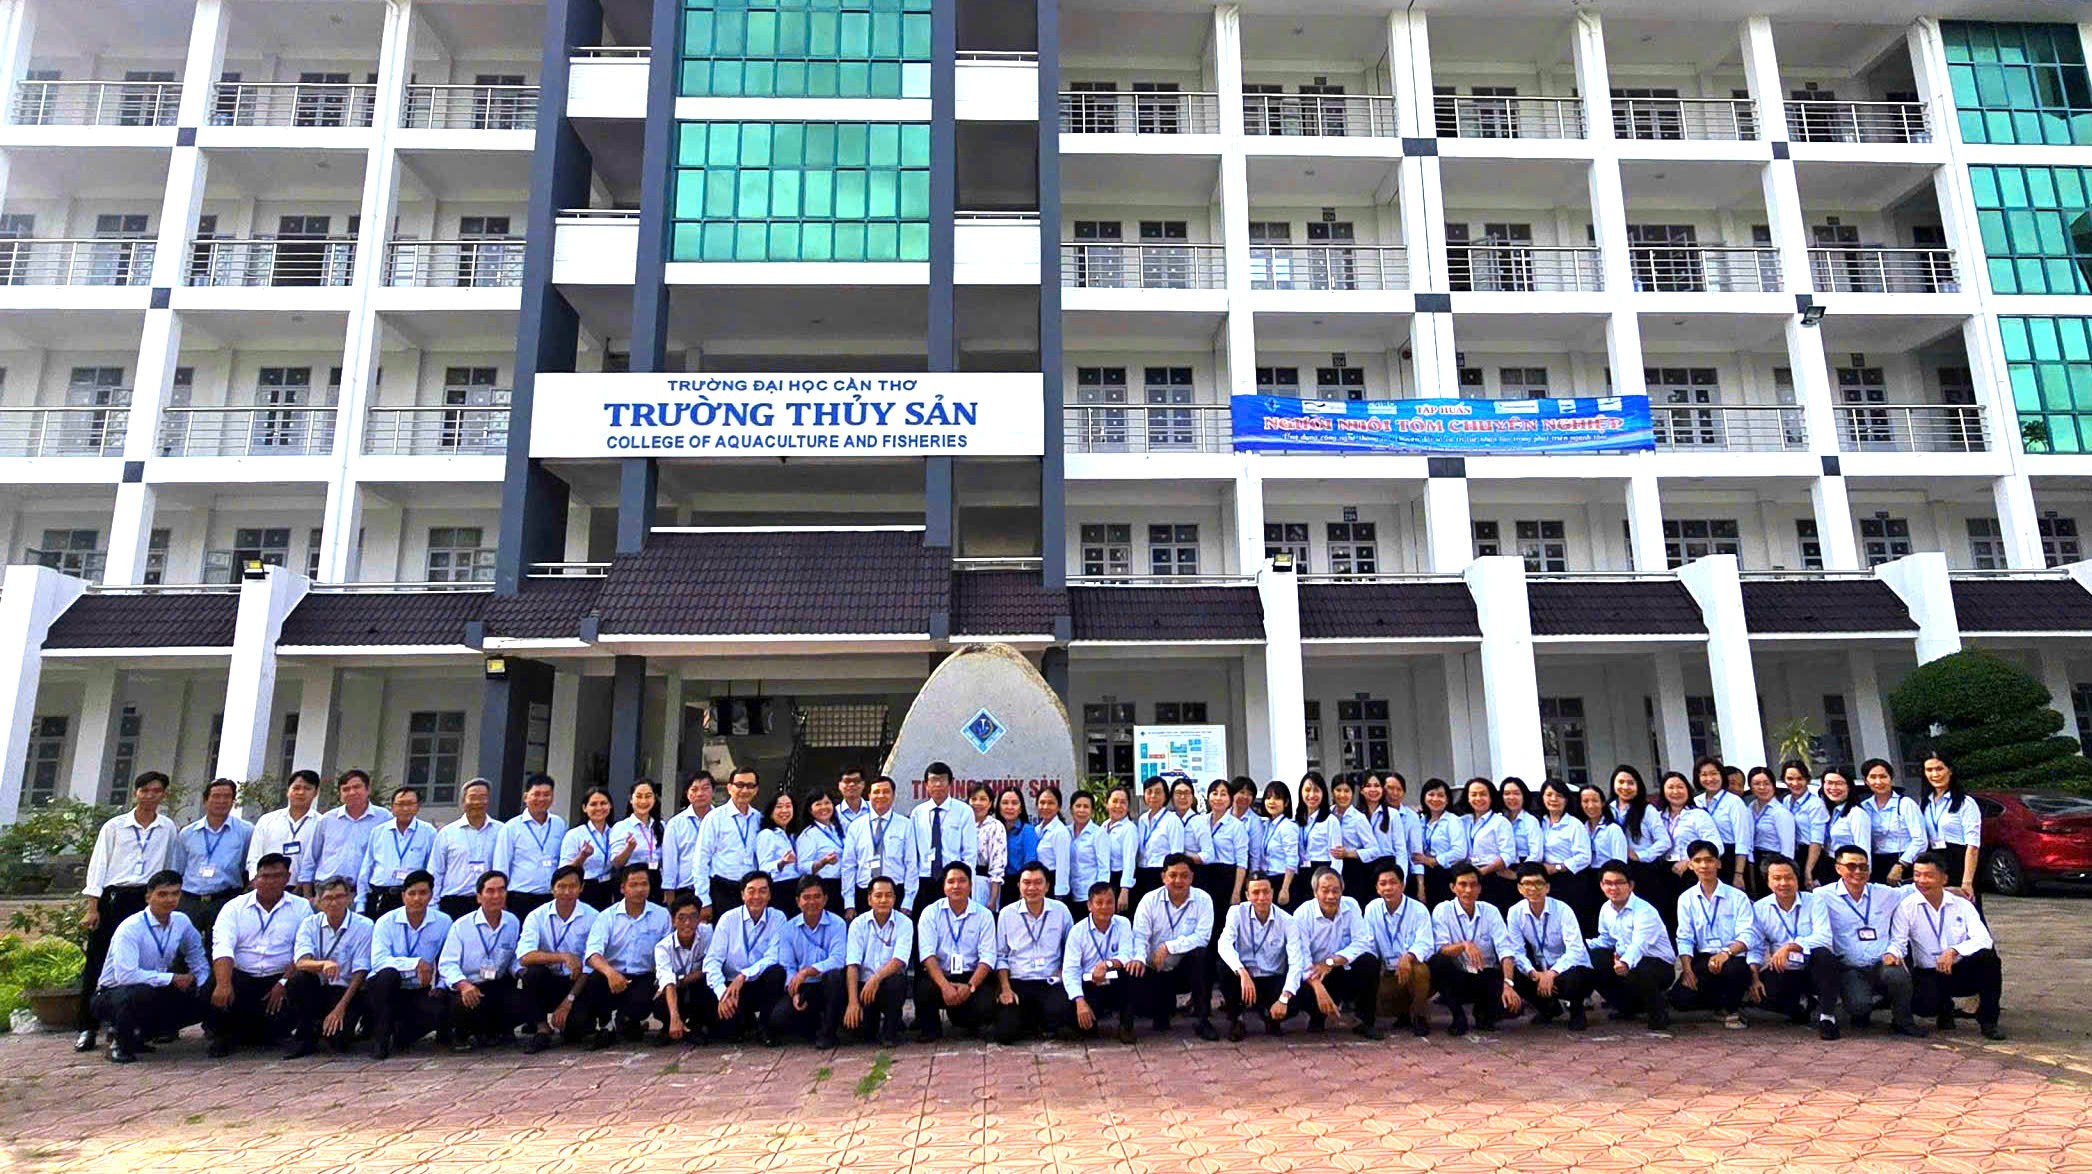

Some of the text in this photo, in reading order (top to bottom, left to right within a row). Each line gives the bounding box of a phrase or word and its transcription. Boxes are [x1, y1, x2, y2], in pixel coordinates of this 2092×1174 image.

[667, 377, 917, 394] TRƯỜNG ĐẠI HỌC CẦN THƠ
[604, 394, 978, 427] TRƯỜNG THỦY SẢN
[1397, 416, 1443, 432] TÔM
[1448, 415, 1538, 432] CHUYÊN
[1541, 414, 1624, 433] NGHIỆP
[607, 434, 968, 449] COLLEGE OF AQUACULTURE AND FISHERIES
